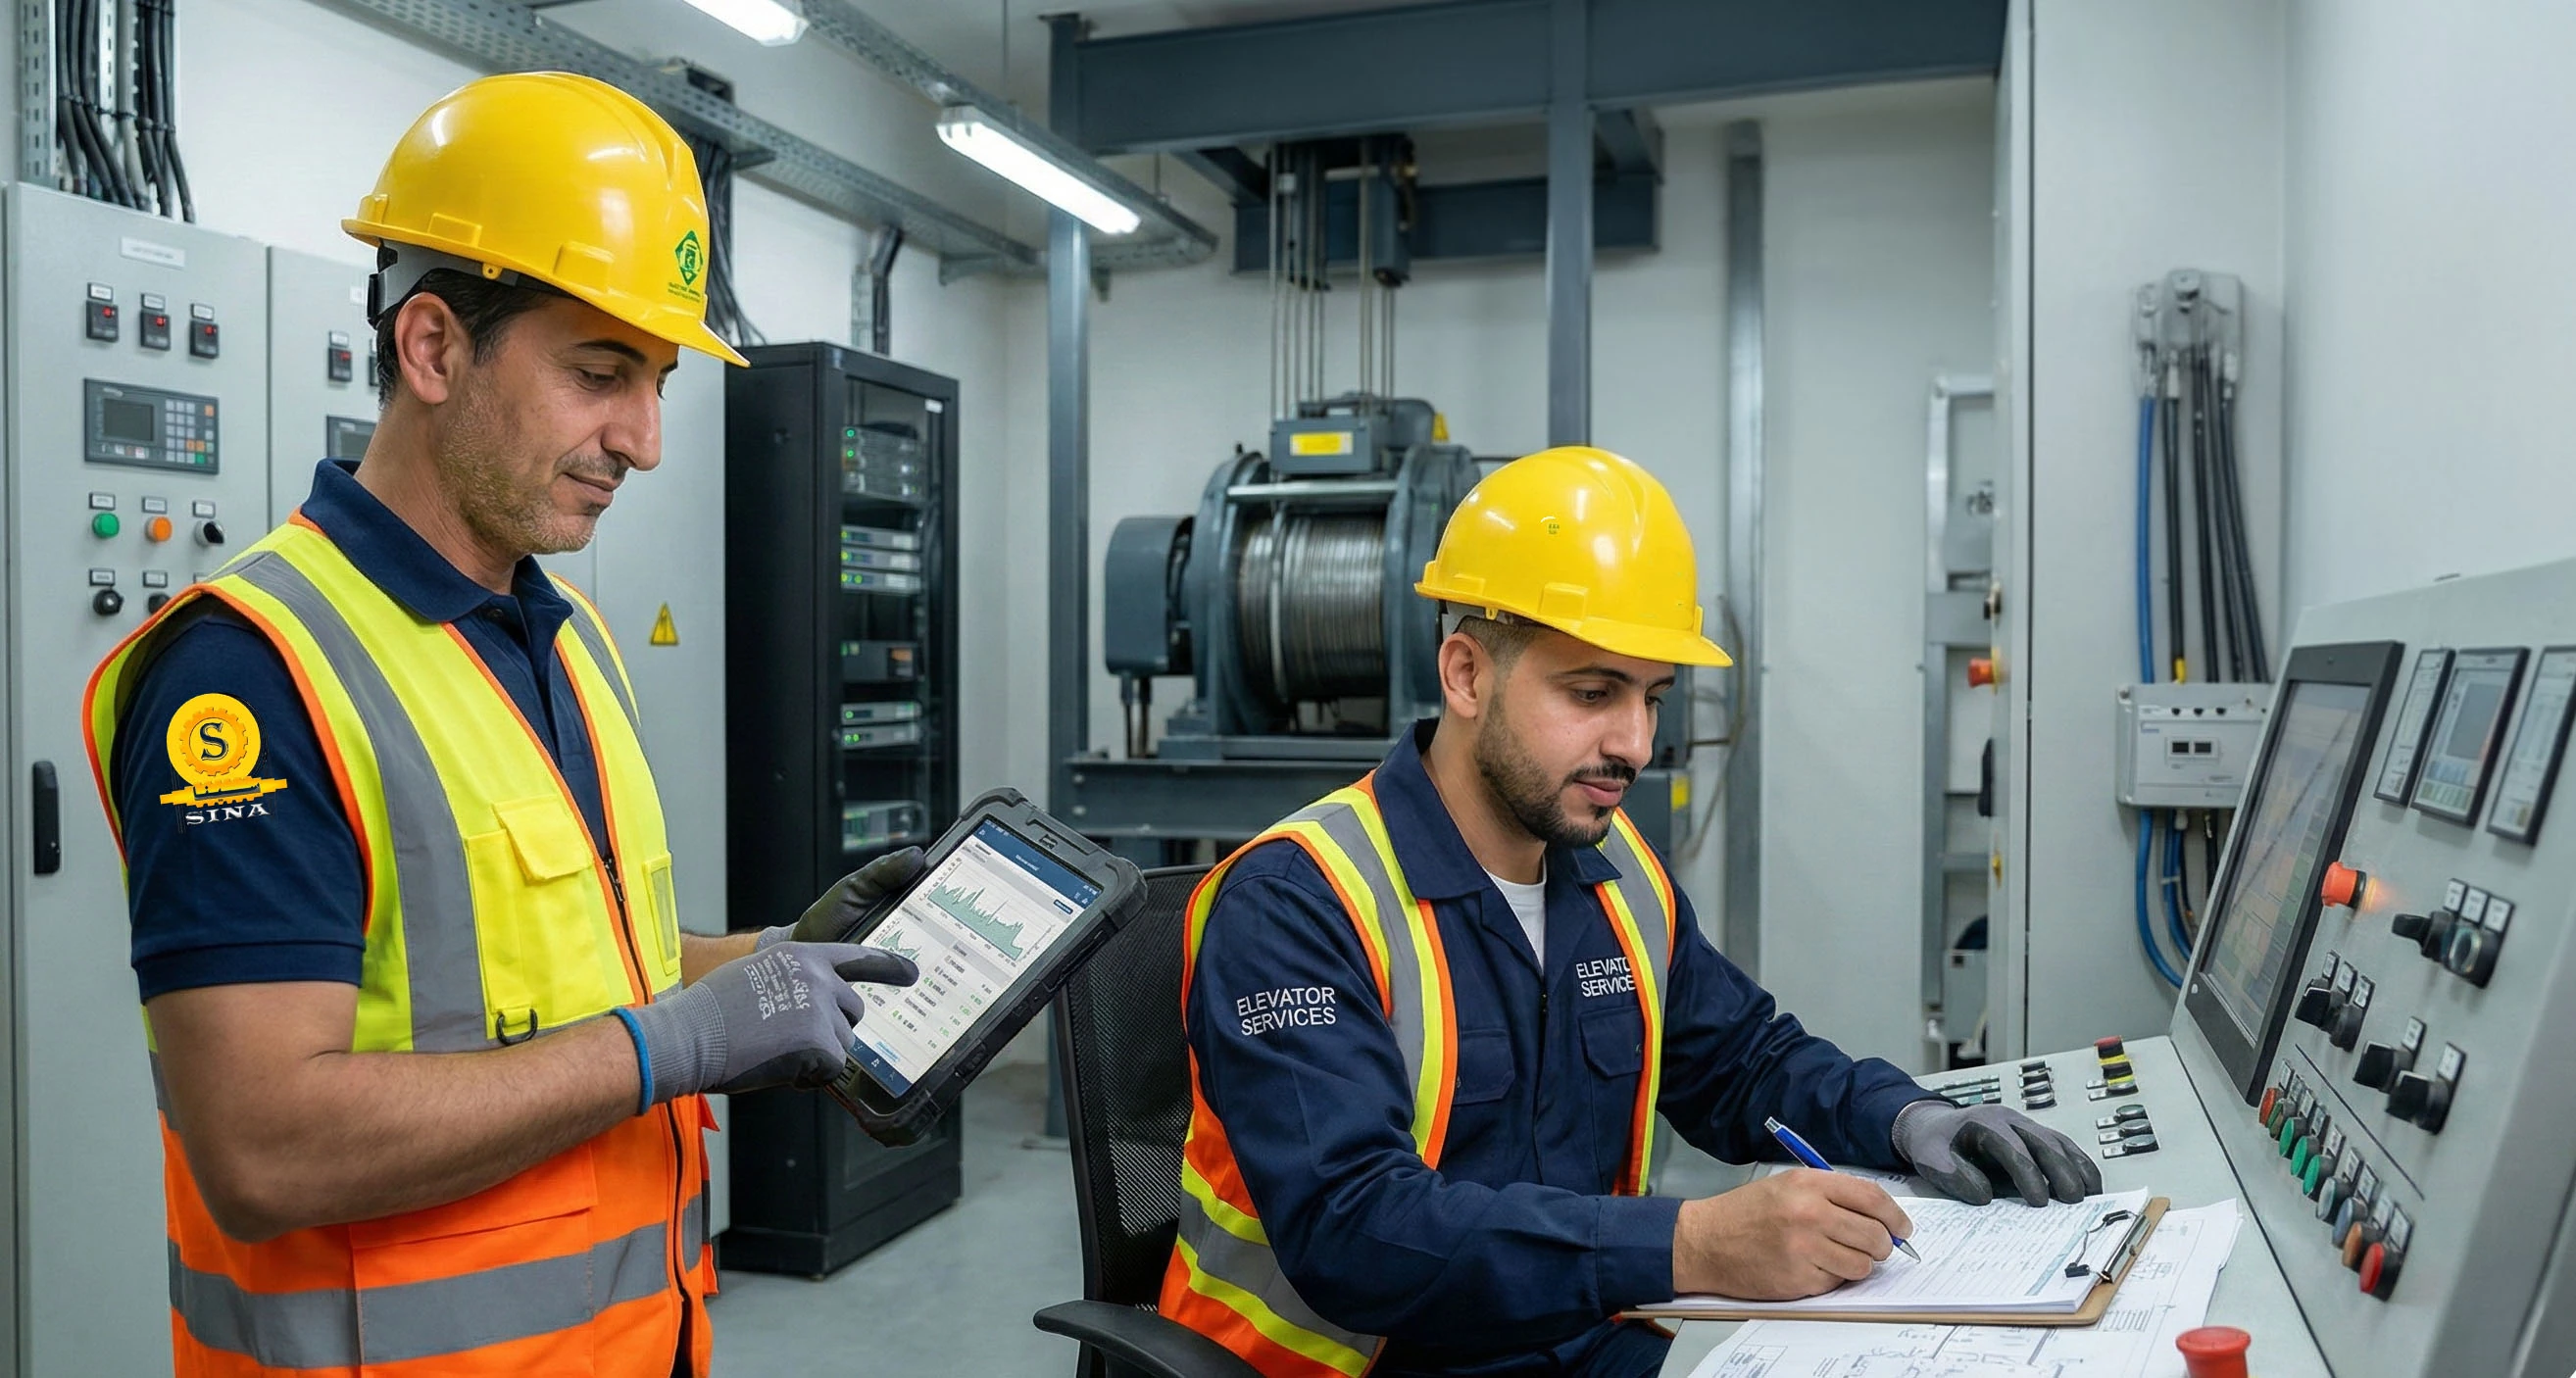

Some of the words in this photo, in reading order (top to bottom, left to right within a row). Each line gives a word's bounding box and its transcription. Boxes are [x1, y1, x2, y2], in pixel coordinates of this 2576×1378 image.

[199, 721, 229, 761] S
[185, 803, 271, 825] SINA
[1575, 956, 1632, 979] ELEVATO
[1581, 974, 1637, 998] SERVICE
[1236, 986, 1337, 1017] ELEVATOR
[1241, 1006, 1337, 1036] SERVICES
